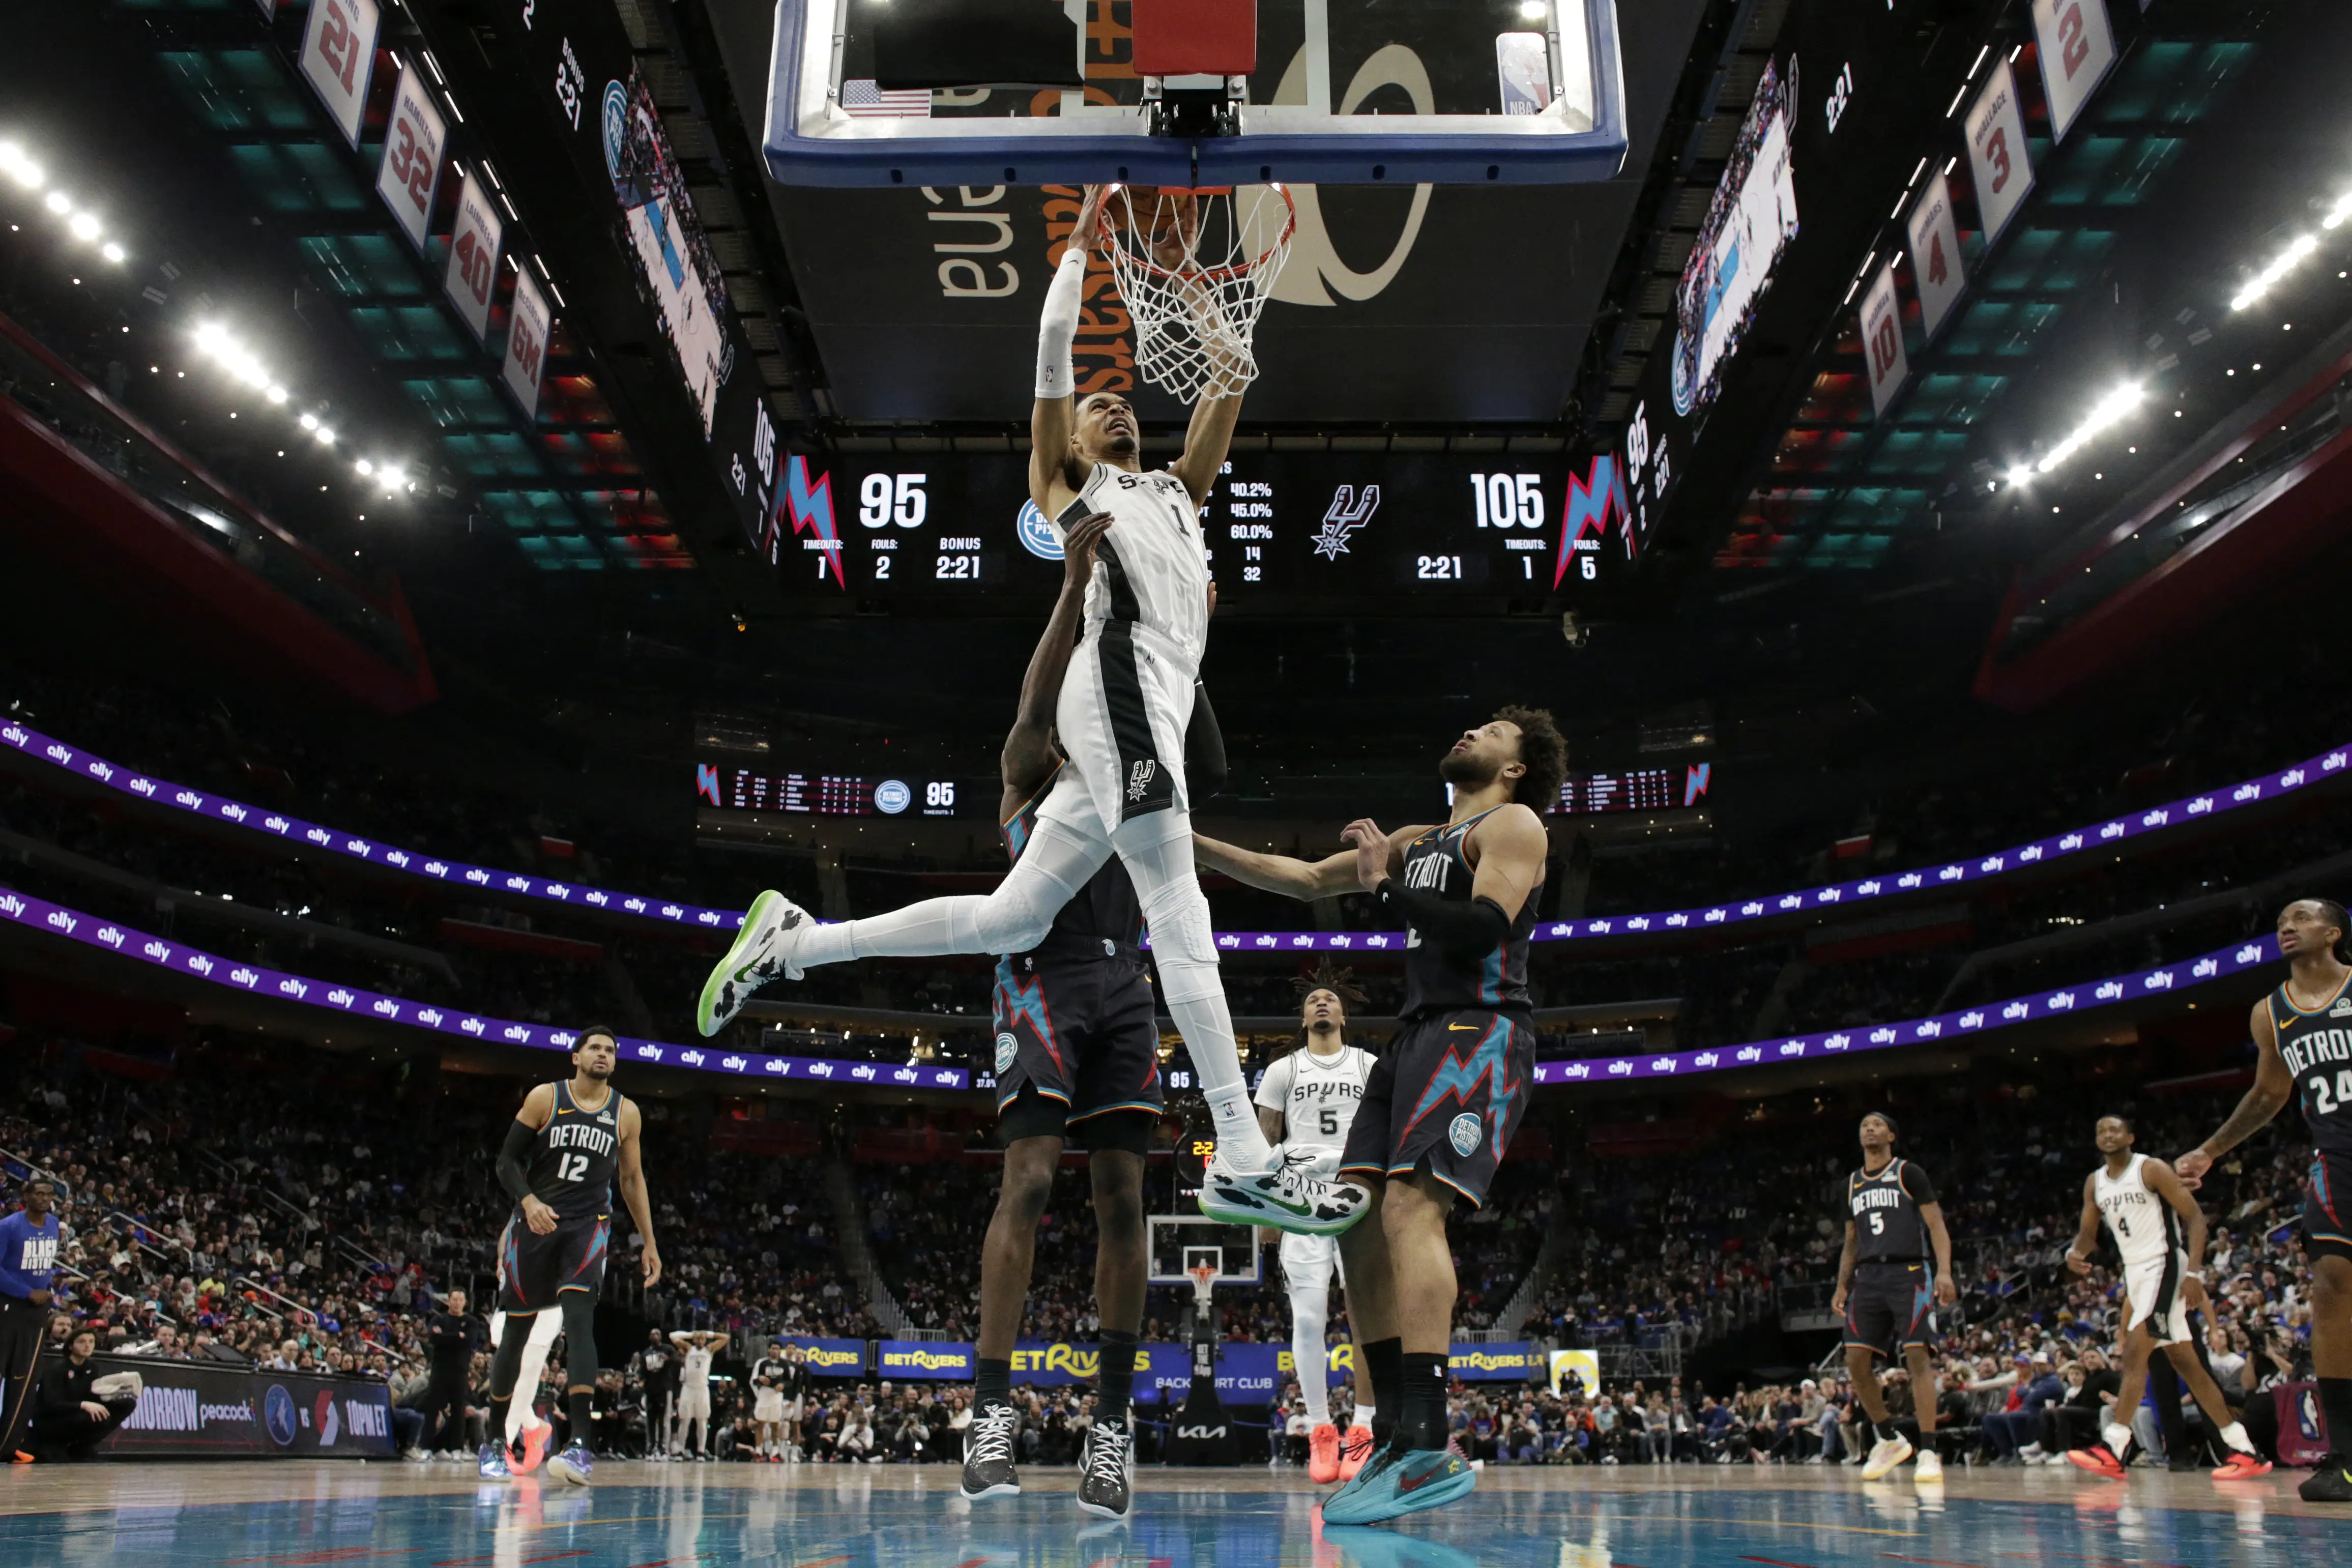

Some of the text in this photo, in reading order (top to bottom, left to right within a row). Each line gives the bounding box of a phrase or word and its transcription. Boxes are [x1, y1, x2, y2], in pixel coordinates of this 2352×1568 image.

[319, 2, 360, 97] 21
[2058, 2, 2089, 80] 2
[563, 37, 585, 93] BONUS
[556, 62, 581, 132] 2:21
[1510, 102, 1533, 115] NBA
[1825, 62, 1853, 133] 2:21
[404, 95, 437, 155] HAMILTON
[391, 118, 432, 216] 32
[1987, 127, 2010, 194] 3
[456, 229, 490, 306] 40
[1929, 231, 1948, 286] 4
[512, 313, 541, 387] GM
[1871, 316, 1897, 386] 10
[753, 397, 775, 487] 105
[1628, 399, 1649, 485] 95
[860, 473, 926, 529] 95
[1230, 482, 1272, 497] 40.2%
[1470, 474, 1545, 528] 105
[1170, 503, 1192, 538] 1
[1230, 503, 1273, 518] 45.0%
[803, 539, 844, 550] TIMEOUTS:
[871, 539, 898, 550] FOULS:
[940, 537, 981, 550] BONUS
[1230, 524, 1273, 539] 60.0%
[1504, 539, 1547, 550] TIMEOUTS:
[1573, 539, 1601, 550] FOULS:
[818, 556, 826, 579] 1
[875, 556, 890, 579] 2
[936, 556, 980, 579] 2:21
[1245, 546, 1261, 561] 14
[1417, 556, 1461, 579] 2:21
[1522, 556, 1532, 579] 1
[1581, 556, 1596, 579] 5
[1243, 566, 1261, 582] 32
[926, 782, 954, 806] 95
[3, 728, 720, 925] ally ally ally ally ally ally ally ally ally ally ally ally ally ally
[1552, 753, 2346, 936] ally ally ally ally ally ally ally ally ally ally ally ally ally ally ally
[1405, 852, 1454, 893] ETROIT
[1219, 935, 1387, 948] ally ally ally ally ally
[48, 912, 77, 933] ally
[144, 942, 170, 962] ally
[189, 955, 213, 975] ally
[231, 968, 258, 988] ally
[328, 990, 355, 1008] ally
[374, 999, 399, 1018] ally
[418, 1009, 443, 1027] ally
[505, 1026, 531, 1042] ally
[638, 1044, 663, 1061] ally
[722, 1056, 747, 1071] ally
[766, 1059, 790, 1075] ally
[809, 1062, 833, 1078] ally
[894, 1068, 918, 1083] ally
[936, 1071, 960, 1086] ally
[1534, 945, 2261, 1081] ly ally ally ally ally ally ally ally ally ally ally ally ally
[2282, 1029, 2352, 1079] DETROI
[1170, 1071, 1189, 1088] 95
[2309, 1069, 2352, 1115] 24
[1319, 1110, 1338, 1136] 5
[549, 1124, 615, 1157] DETROIT
[1193, 1141, 1213, 1155] 2:2
[557, 1152, 589, 1182] 12
[1852, 1187, 1900, 1216] DETROIT
[1869, 1211, 1884, 1235] 5
[2118, 1216, 2131, 1237] 4
[1237, 1377, 1273, 1389] CLUB
[121, 1386, 197, 1431] MORROW
[199, 1400, 252, 1429] peacock
